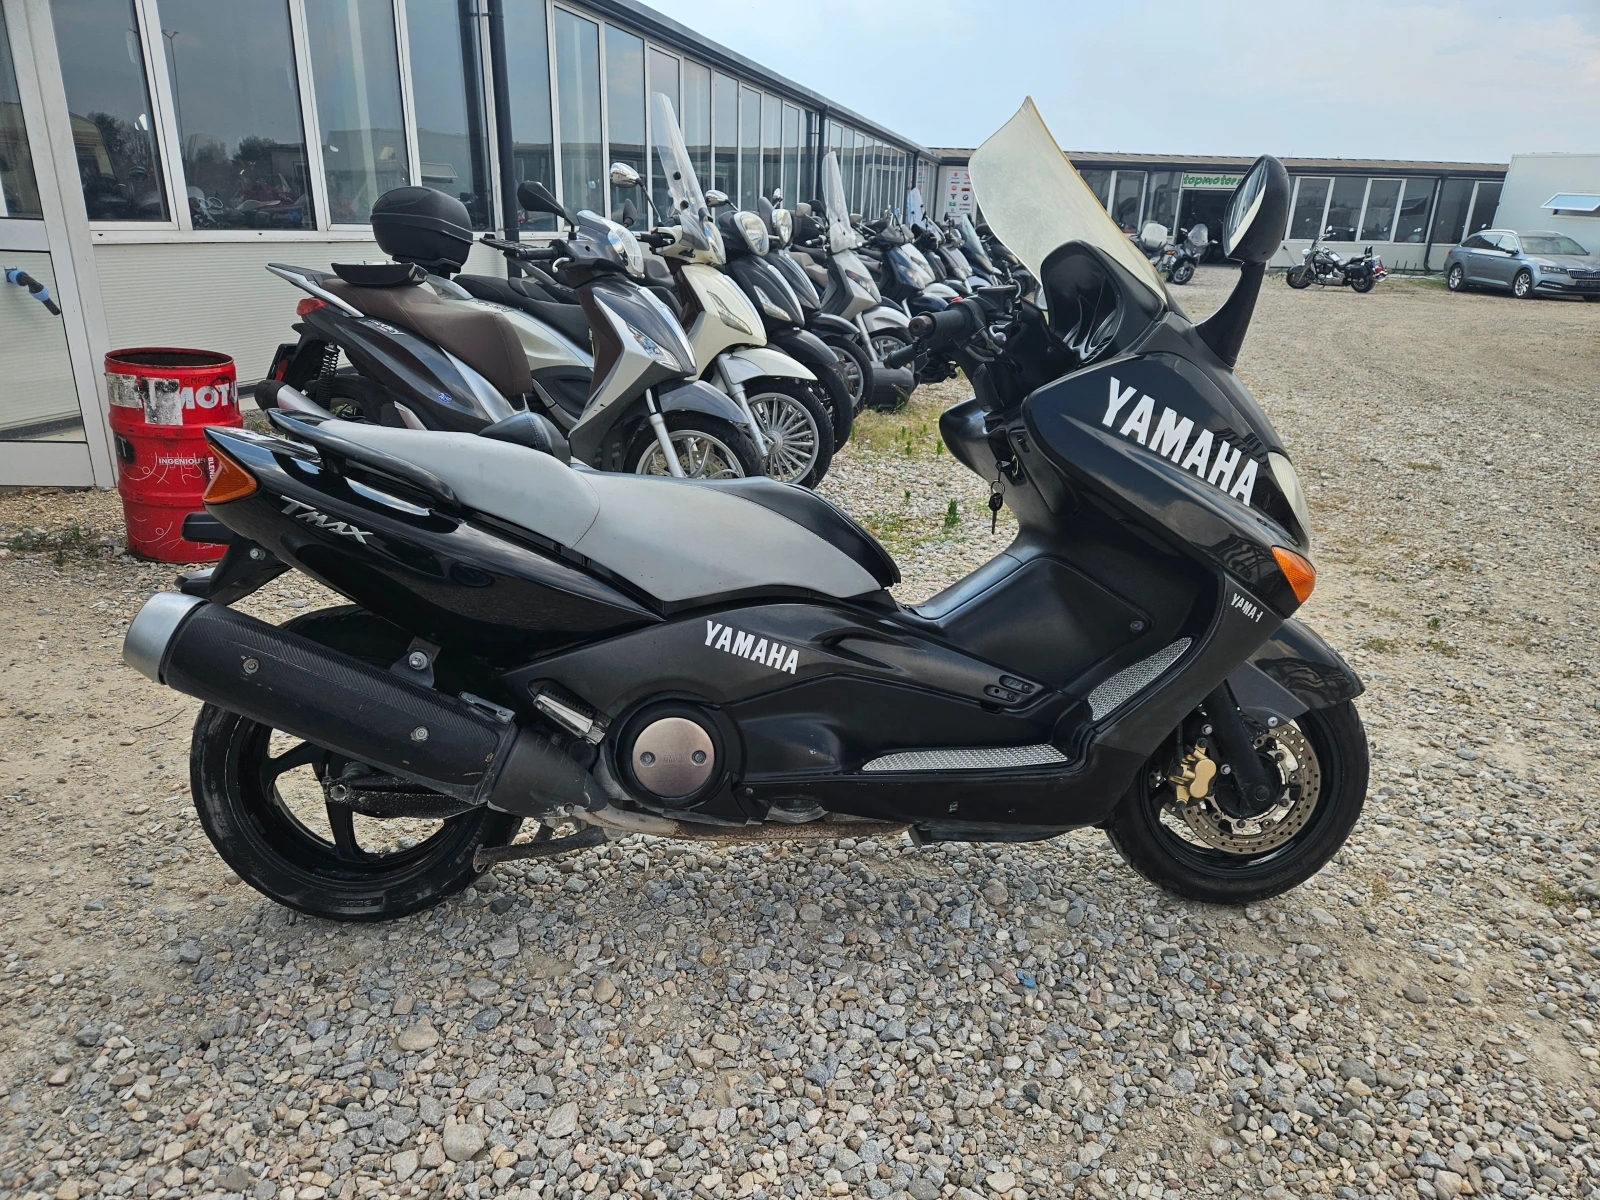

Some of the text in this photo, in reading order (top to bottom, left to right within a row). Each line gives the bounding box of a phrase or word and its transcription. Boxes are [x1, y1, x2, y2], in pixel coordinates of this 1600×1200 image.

[1101, 376, 1259, 507] YAMAHA
[280, 495, 374, 544] TMAX
[704, 619, 800, 675] YAMAHA
